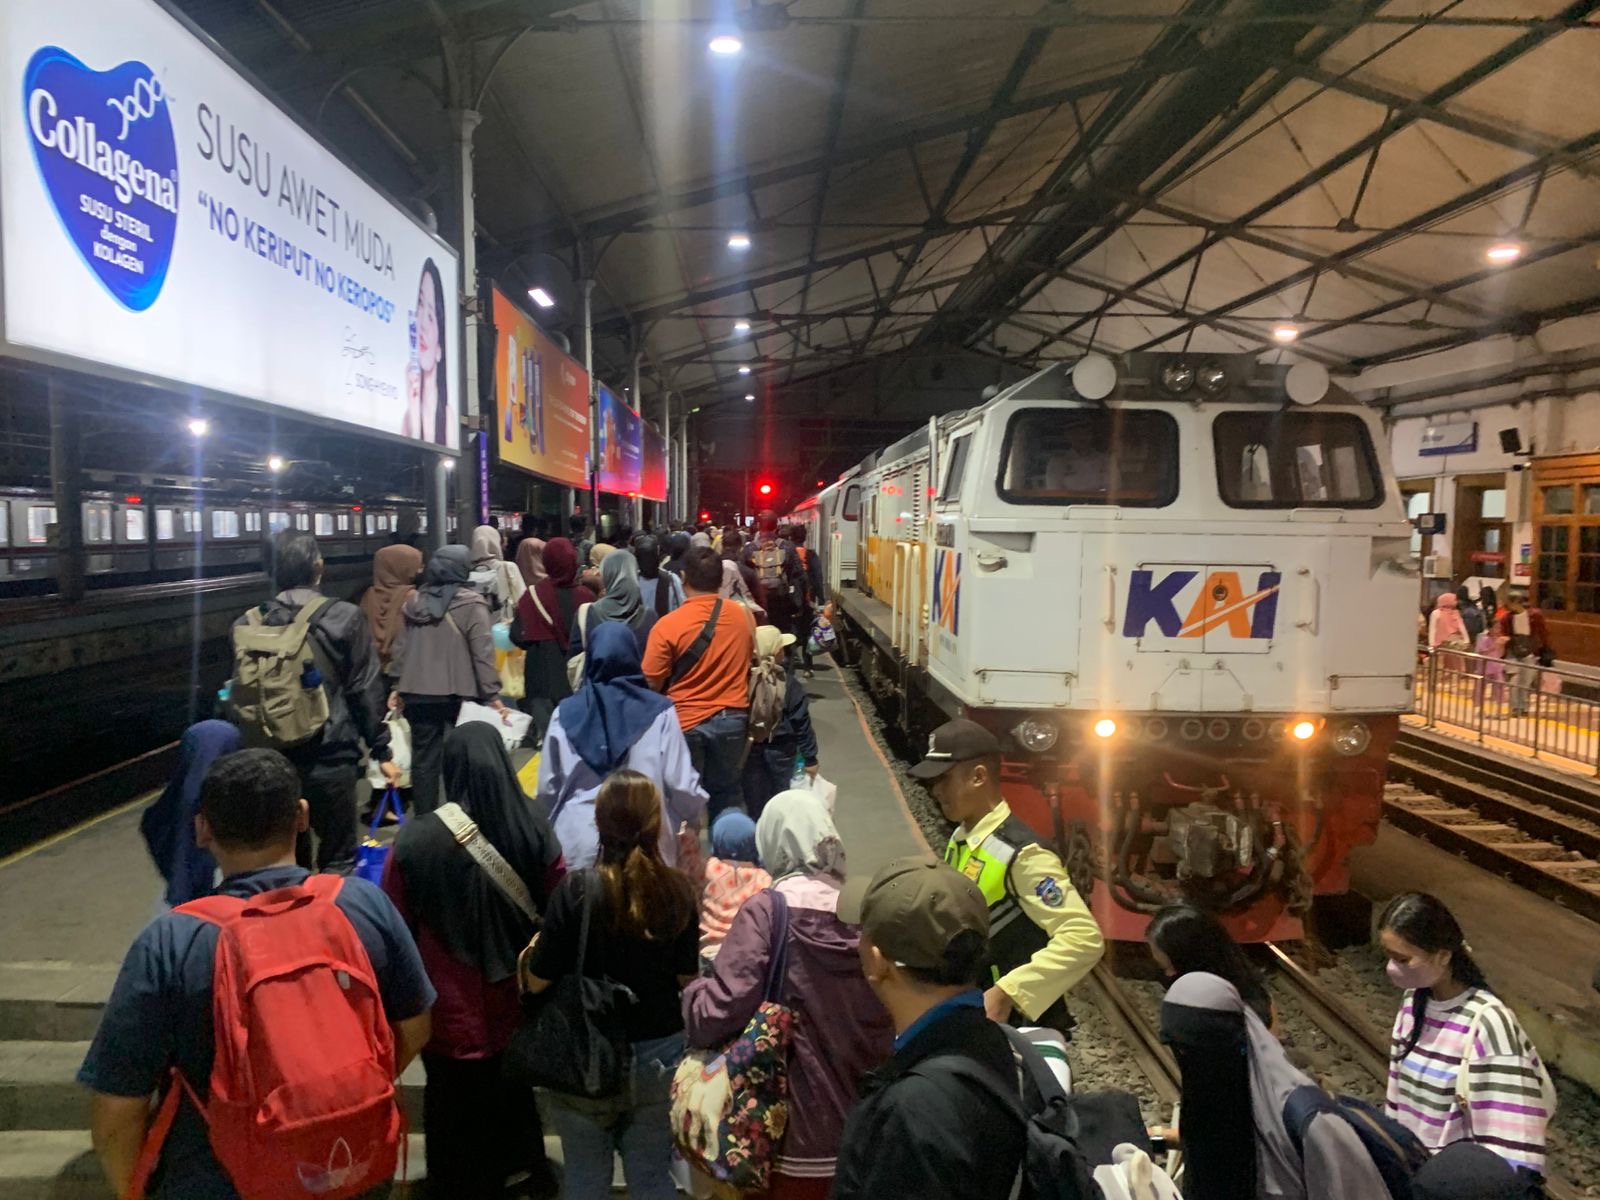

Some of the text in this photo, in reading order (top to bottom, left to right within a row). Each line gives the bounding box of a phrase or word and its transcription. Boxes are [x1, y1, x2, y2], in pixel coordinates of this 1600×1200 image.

[29, 88, 177, 213] Collagena
[79, 193, 154, 243] SUSU STERIL
[197, 102, 395, 281] SUSU AWET MUDA
[93, 241, 145, 275] KOLAGEN
[100, 223, 138, 252] dengan
[244, 217, 311, 281] KERIPUT
[315, 258, 336, 293] NO
[932, 547, 962, 637] KAI
[1122, 570, 1282, 640] KAI
